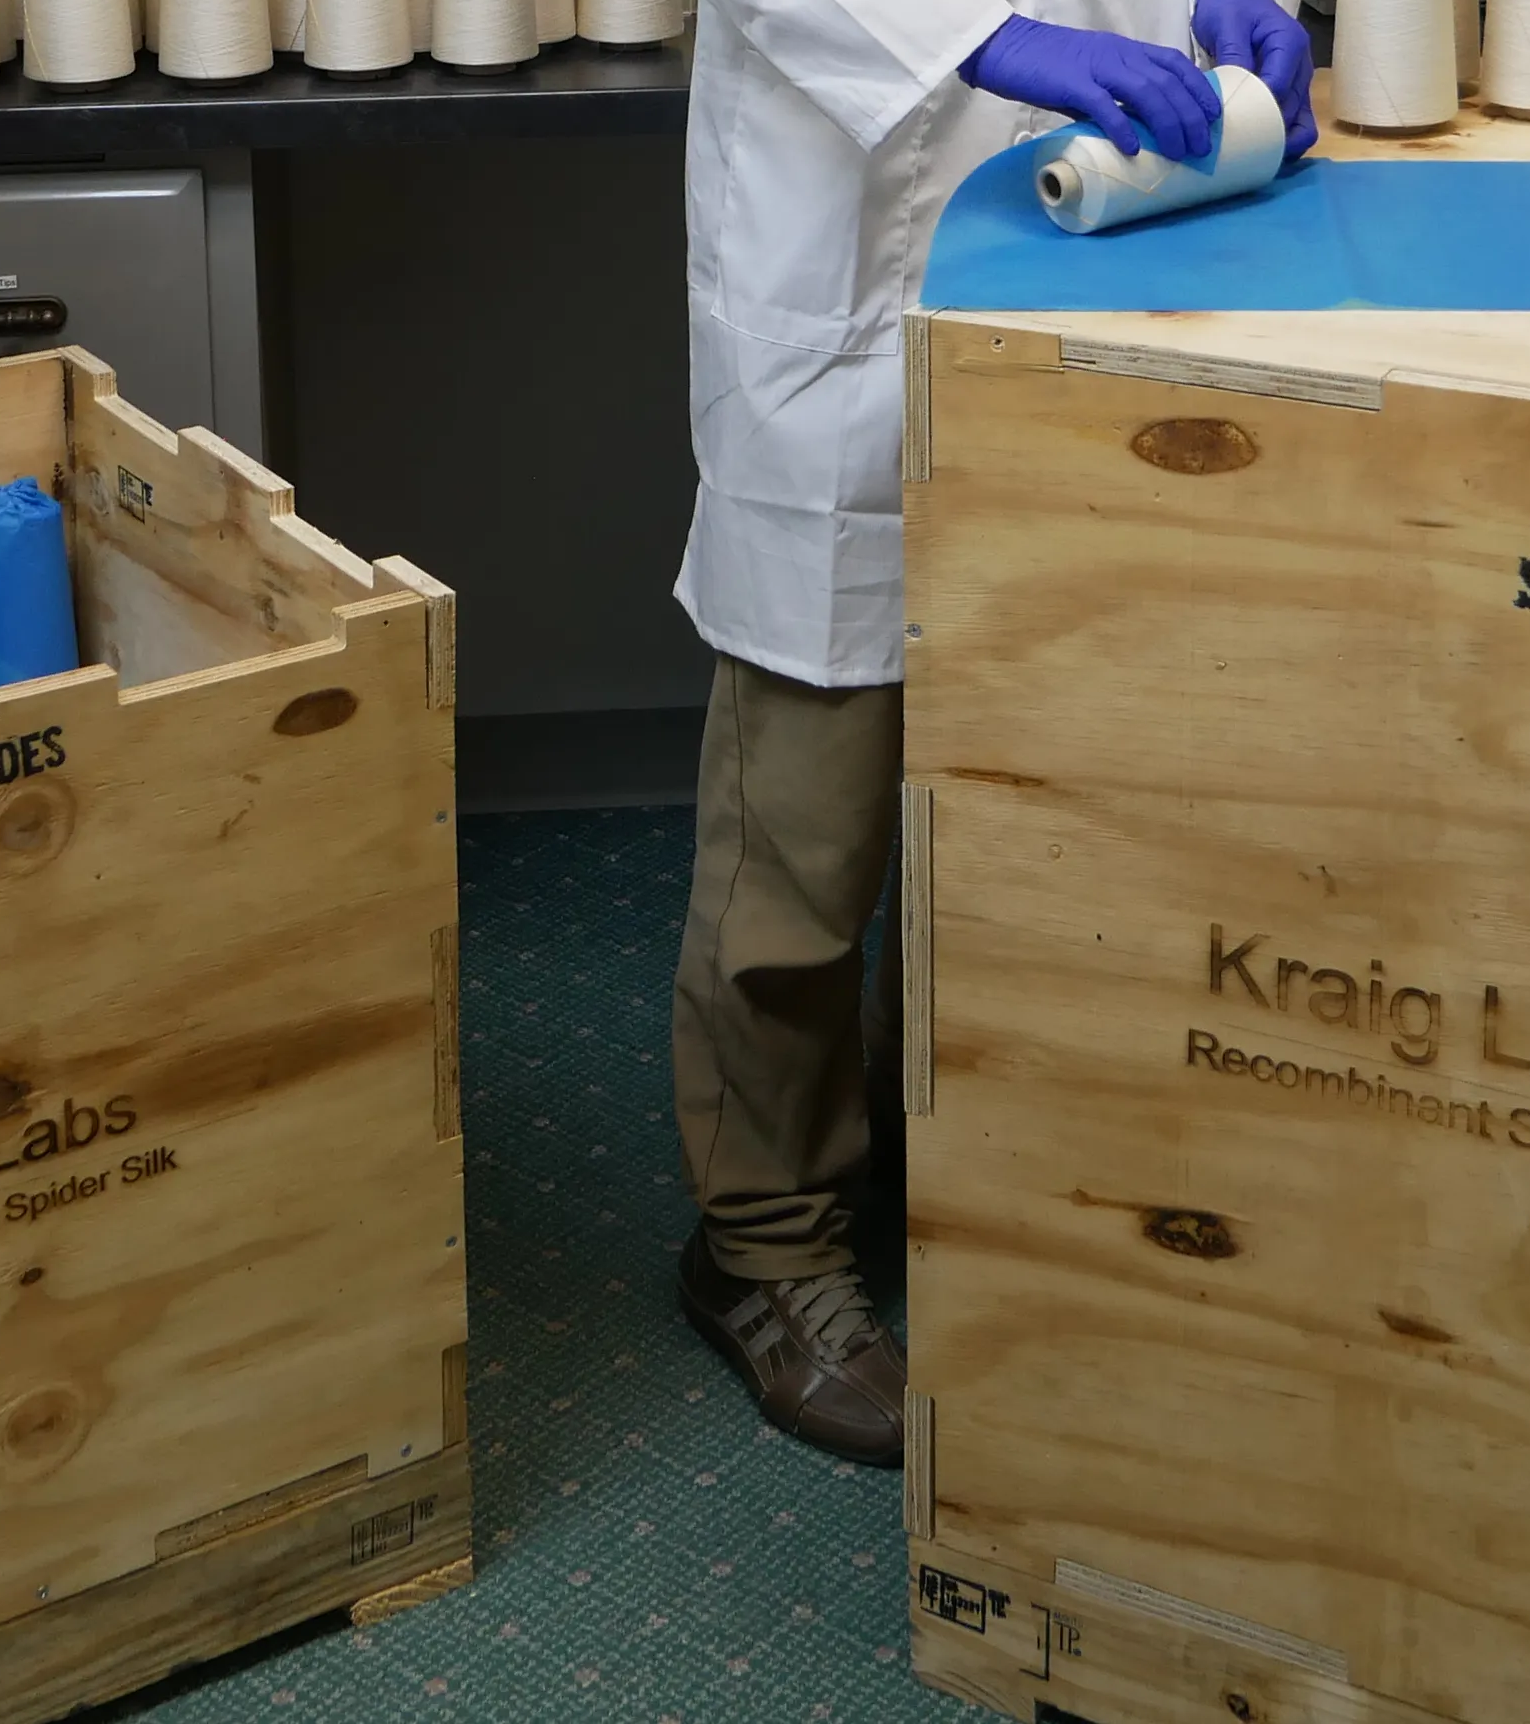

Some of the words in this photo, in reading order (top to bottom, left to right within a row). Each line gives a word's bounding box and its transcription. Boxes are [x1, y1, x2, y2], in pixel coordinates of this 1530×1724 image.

[1208, 922, 1442, 1066] Kraig
[1186, 1027, 1495, 1140] Recombinant
[4, 1169, 112, 1225] Spider
[120, 1145, 181, 1186] Silk
